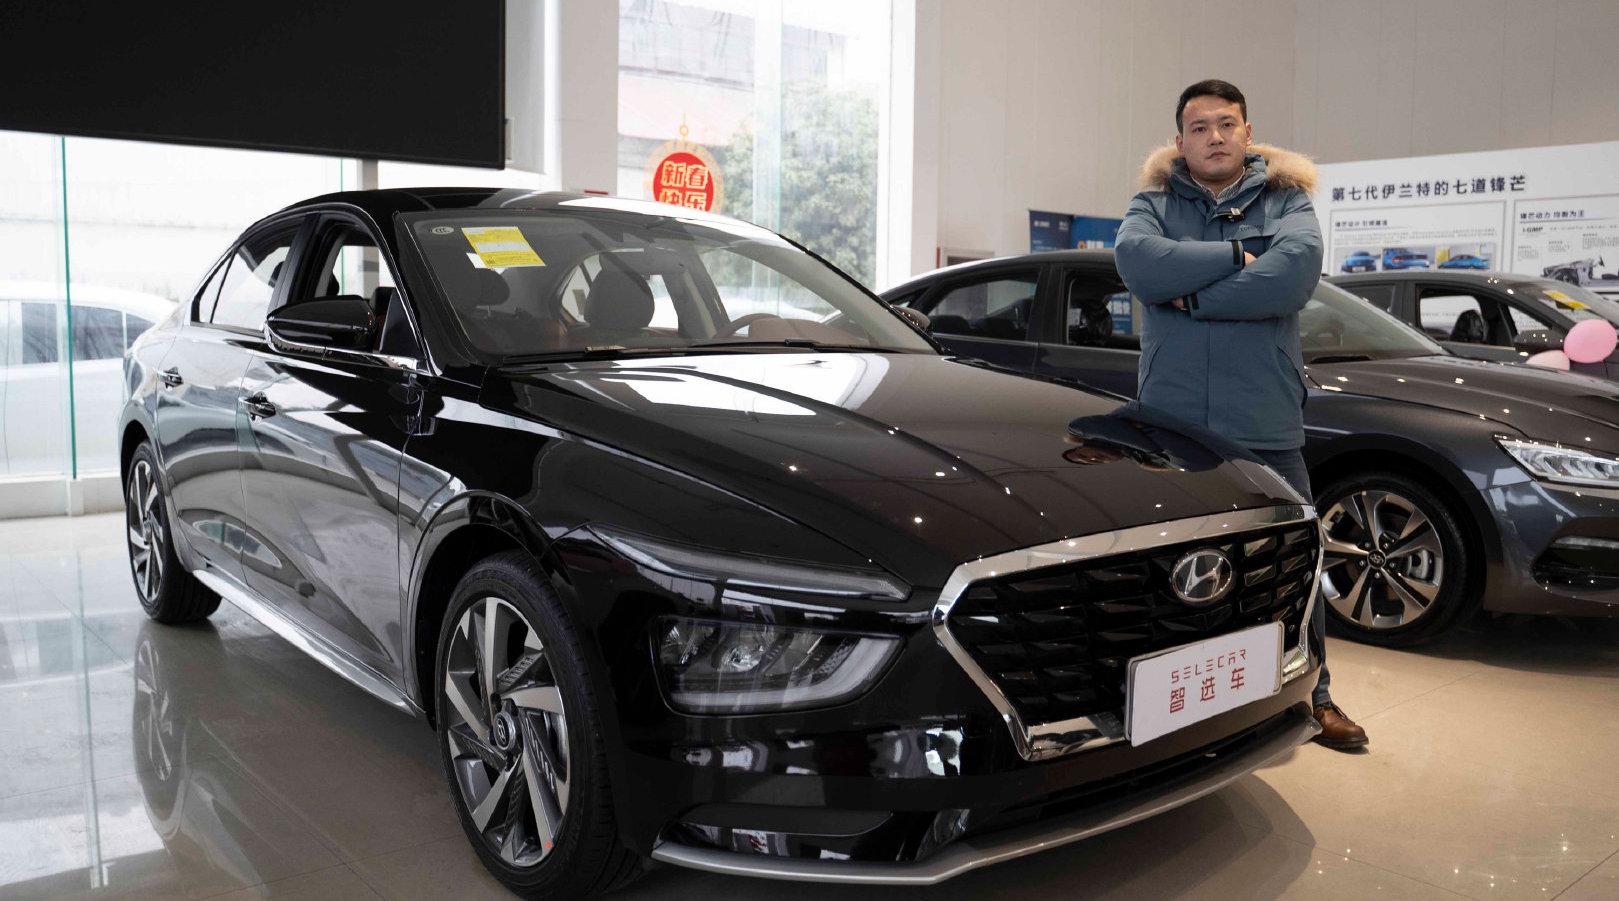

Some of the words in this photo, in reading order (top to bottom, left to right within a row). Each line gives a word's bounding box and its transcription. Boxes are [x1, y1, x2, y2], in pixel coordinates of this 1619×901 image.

[660, 160, 709, 189] 新春
[1332, 175, 1526, 202] 第七代伊兰特的七道锋芒
[1171, 649, 1246, 684] SELECAR
[1170, 667, 1245, 713] 智选车
